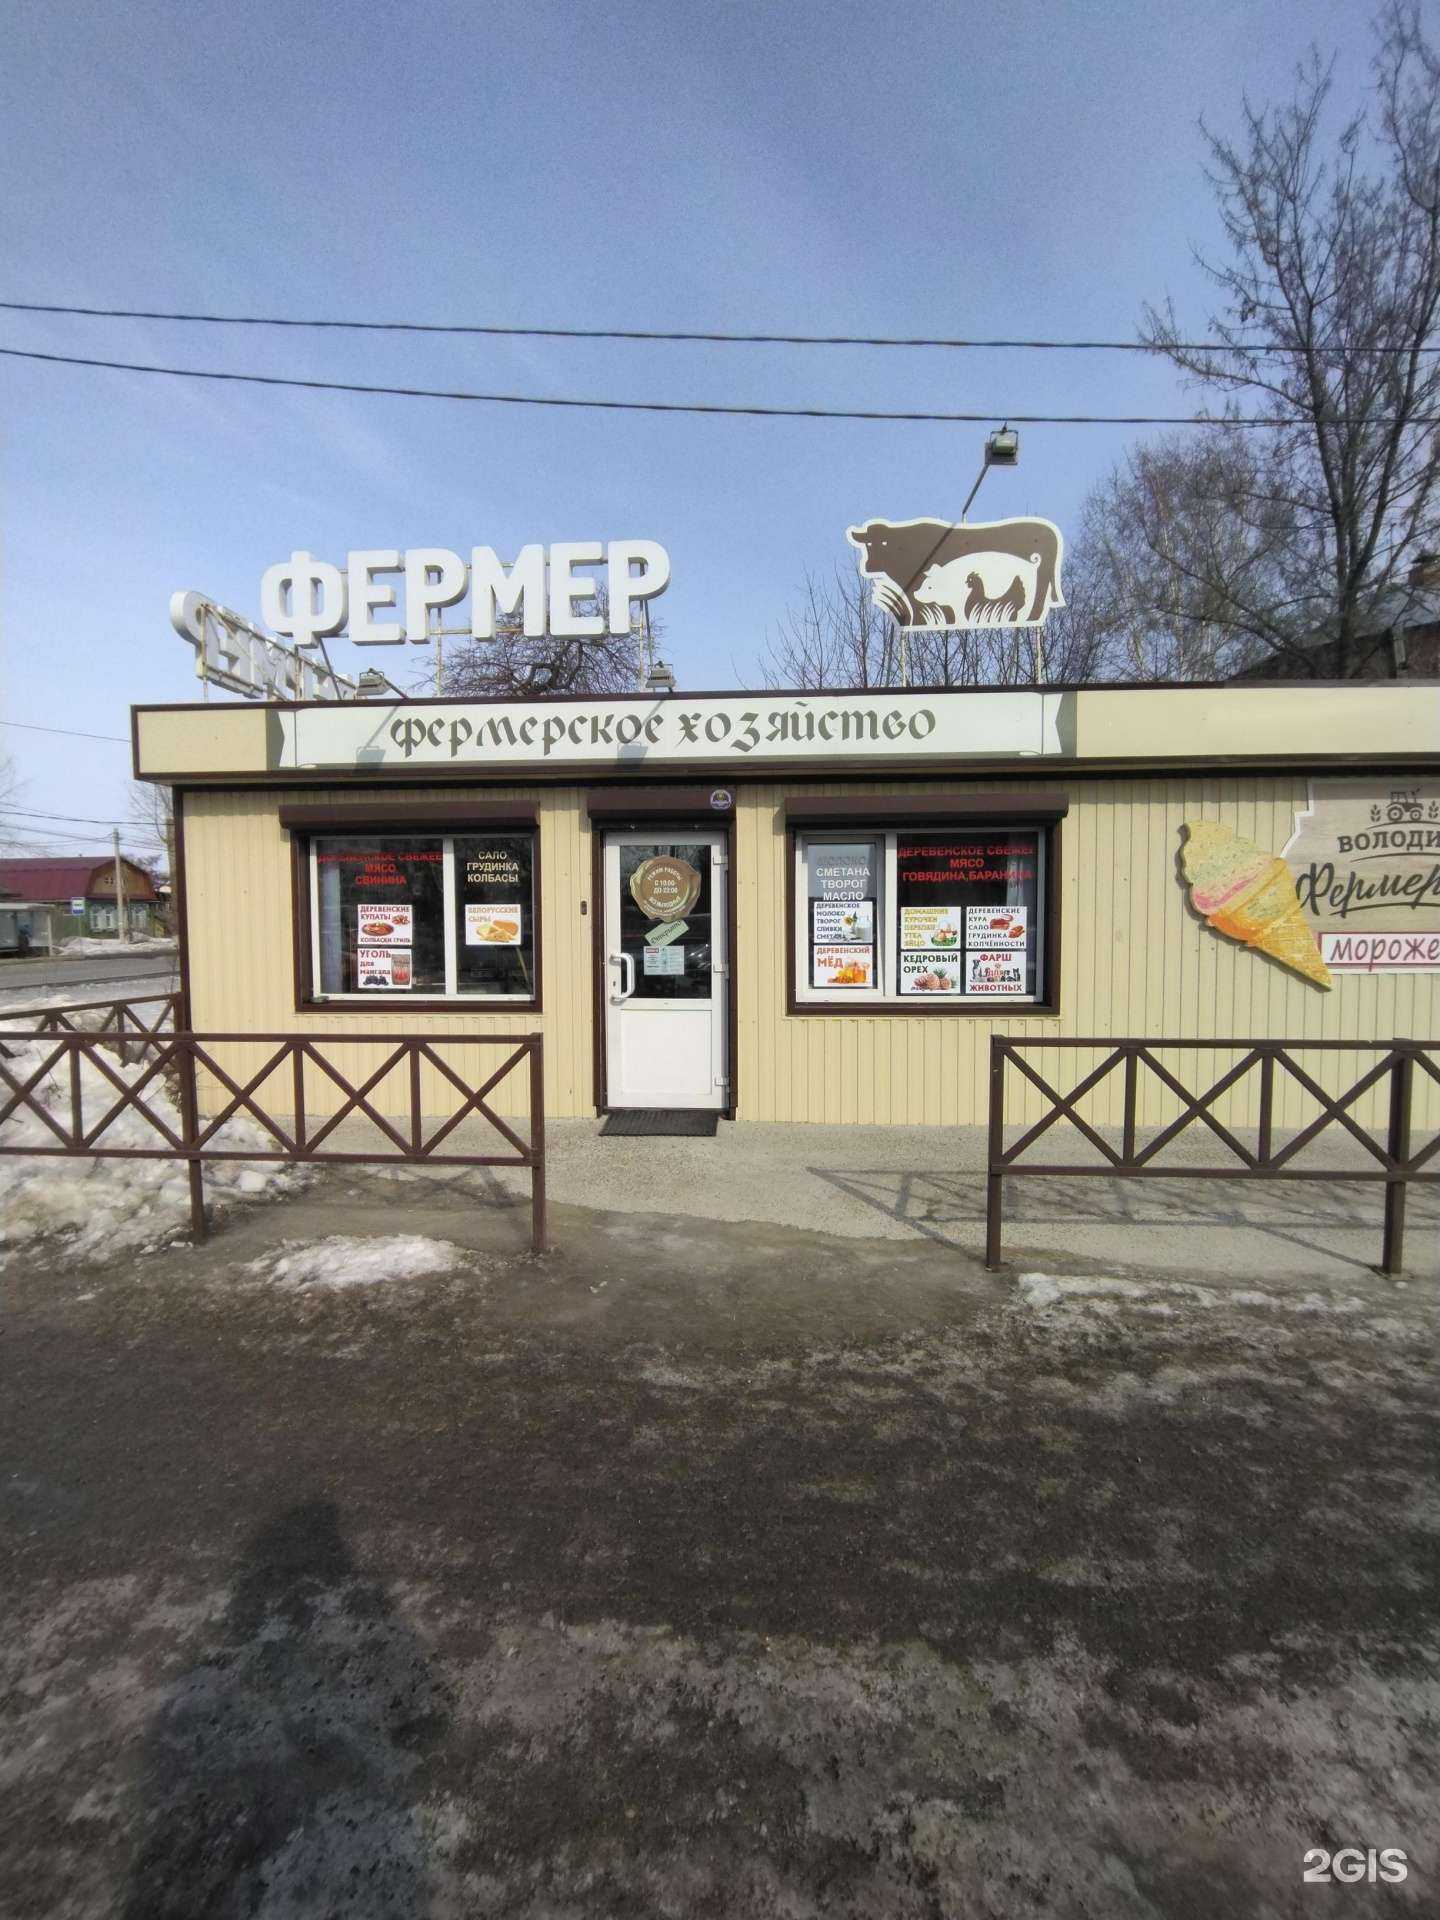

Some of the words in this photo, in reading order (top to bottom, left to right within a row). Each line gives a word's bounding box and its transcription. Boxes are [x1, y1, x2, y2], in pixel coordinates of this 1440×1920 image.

[260, 539, 671, 650] ФЕРМЕР
[390, 713, 664, 757] фермерское
[679, 701, 936, 752] хозяйство
[478, 851, 507, 860] САЛО
[897, 847, 984, 858] ДЕРЕВЕНСКОЕ
[364, 863, 396, 873] МЯСО
[466, 862, 519, 873] ГРУДИНКА
[949, 858, 985, 868] МЯСО
[816, 867, 870, 877] СМЕТАНА
[467, 874, 519, 883] КОЛБАСЫ
[821, 879, 866, 889] ТВОРОГ
[823, 891, 864, 901] МАСЛО
[816, 947, 870, 955] ДЕРЕВЕНСКИЙ
[817, 956, 843, 968] МЁД
[904, 953, 958, 963] КЕДРОВЫЙ
[979, 953, 1012, 961] ФАРШ
[904, 965, 929, 974] ОРЕХ
[969, 983, 1023, 991] ЖИВОТНЫХ
